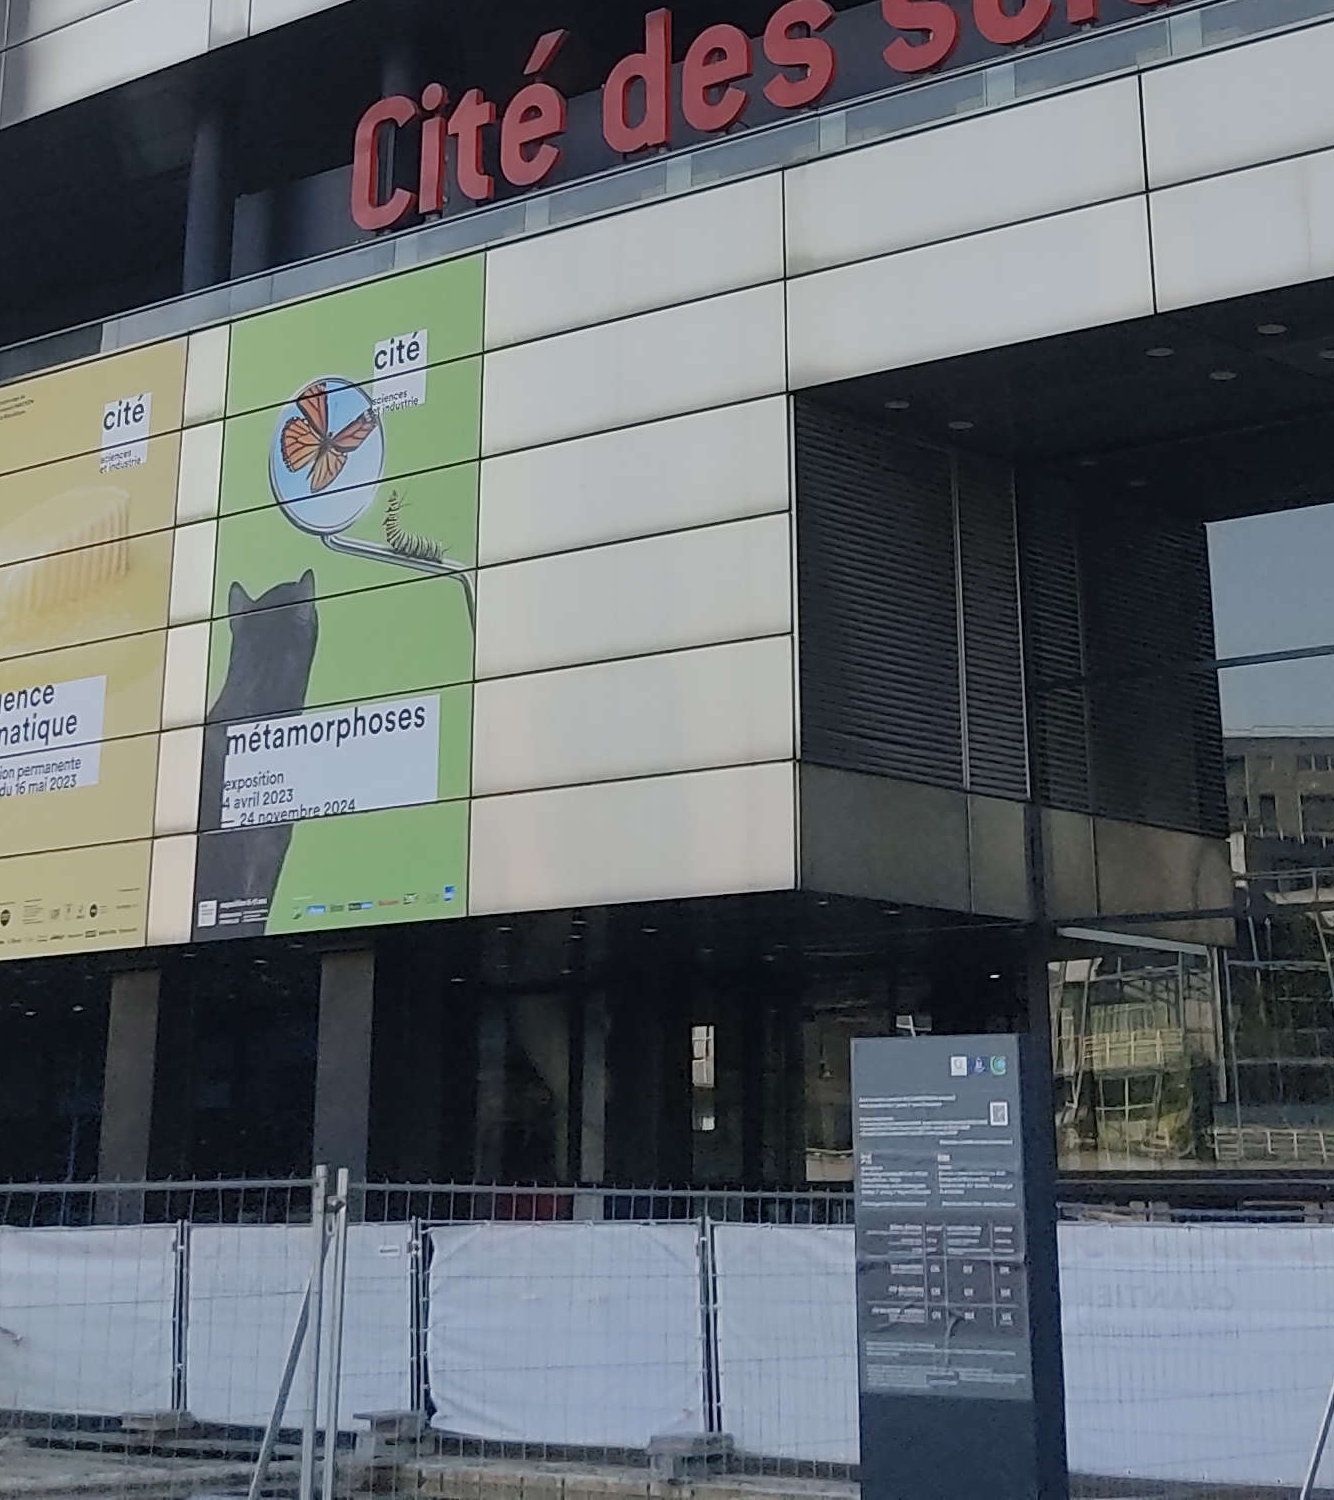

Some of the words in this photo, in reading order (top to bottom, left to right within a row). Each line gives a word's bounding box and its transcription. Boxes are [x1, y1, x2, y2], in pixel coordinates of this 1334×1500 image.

[351, 29, 565, 231] Cité
[374, 331, 420, 370] cité
[372, 390, 408, 405] sciences
[382, 397, 418, 414] industrie
[103, 394, 144, 431] cité
[99, 463, 107, 474] et
[108, 456, 141, 471] industrie
[100, 449, 131, 464] sciences
[226, 705, 426, 756] métamorphoses
[17, 757, 82, 781] permanente
[0, 783, 12, 798] du
[16, 780, 26, 795] 16
[28, 776, 48, 794] mai
[49, 773, 77, 791] 2023
[223, 770, 284, 793] exposition
[233, 791, 260, 809] avril
[263, 788, 294, 806] 2023
[240, 811, 255, 826] 24
[258, 804, 320, 824] novembre
[324, 799, 356, 817] 2024
